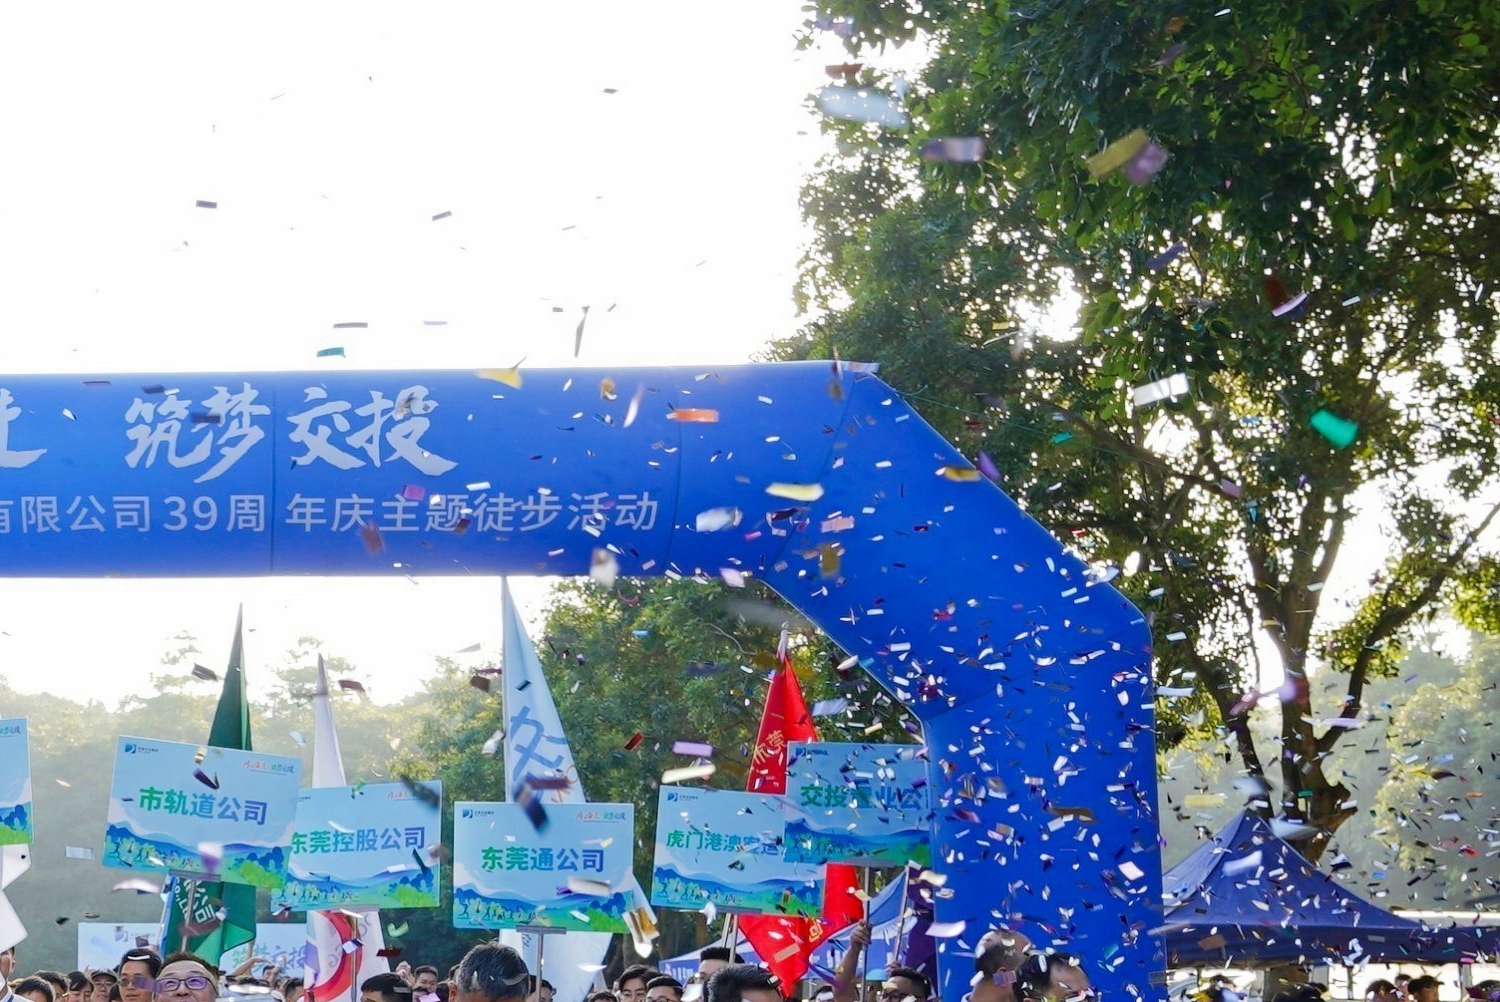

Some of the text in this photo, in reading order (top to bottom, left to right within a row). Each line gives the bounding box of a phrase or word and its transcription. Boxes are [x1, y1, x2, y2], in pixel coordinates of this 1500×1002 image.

[124, 381, 459, 484] 筑梦交投
[138, 786, 268, 826] 市轨道公司
[291, 826, 426, 855] 东莞控股公司
[481, 846, 605, 873] 东莞通公司
